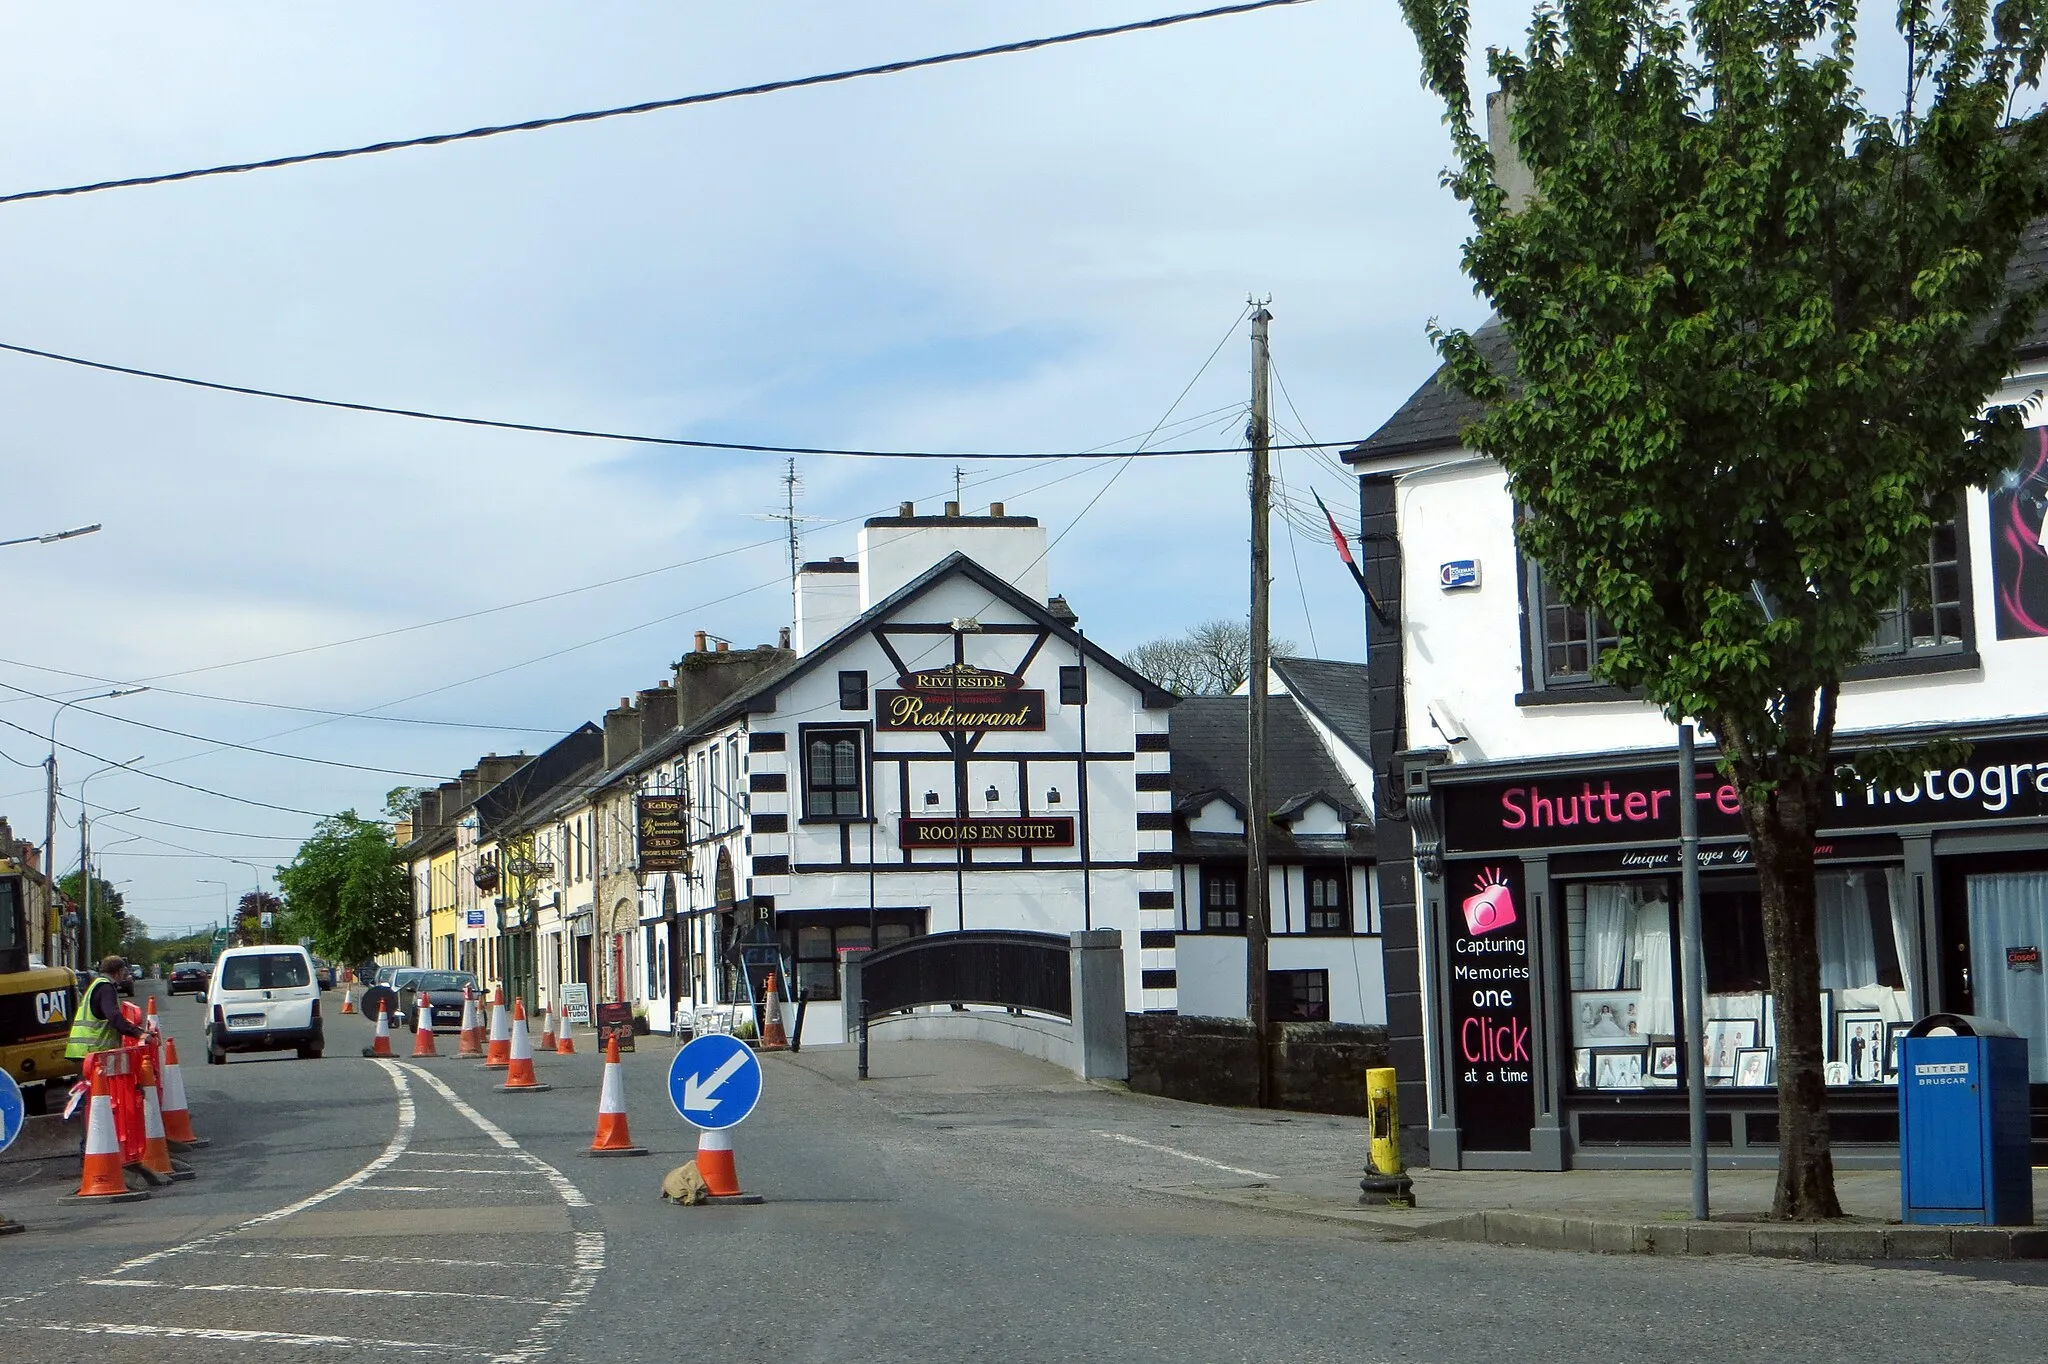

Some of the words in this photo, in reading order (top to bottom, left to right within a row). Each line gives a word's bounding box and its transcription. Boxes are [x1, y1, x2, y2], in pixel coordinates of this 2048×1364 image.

[890, 696, 1031, 727] Restaurant
[648, 801, 679, 810] Kellys
[1502, 781, 1671, 829] Shutter
[919, 826, 978, 840] ROOMS
[981, 826, 1003, 839] EN
[1007, 825, 1056, 839] SUITE
[655, 839, 672, 847] BAR
[1621, 851, 1669, 869] Unique
[1677, 850, 1724, 866] ages
[1732, 845, 1749, 863] by
[1456, 936, 1525, 956] Capturing
[2008, 953, 2037, 963] Closed
[1455, 964, 1530, 981] Memories
[1472, 988, 1513, 1008] one
[36, 990, 68, 1025] CAT
[1462, 1016, 1529, 1062] Click
[1464, 1068, 1478, 1083] at
[1486, 1071, 1495, 1083] a
[1500, 1067, 1529, 1083] time
[1917, 1065, 1967, 1074] LITTER
[1918, 1077, 1967, 1086] BRUSCAR
